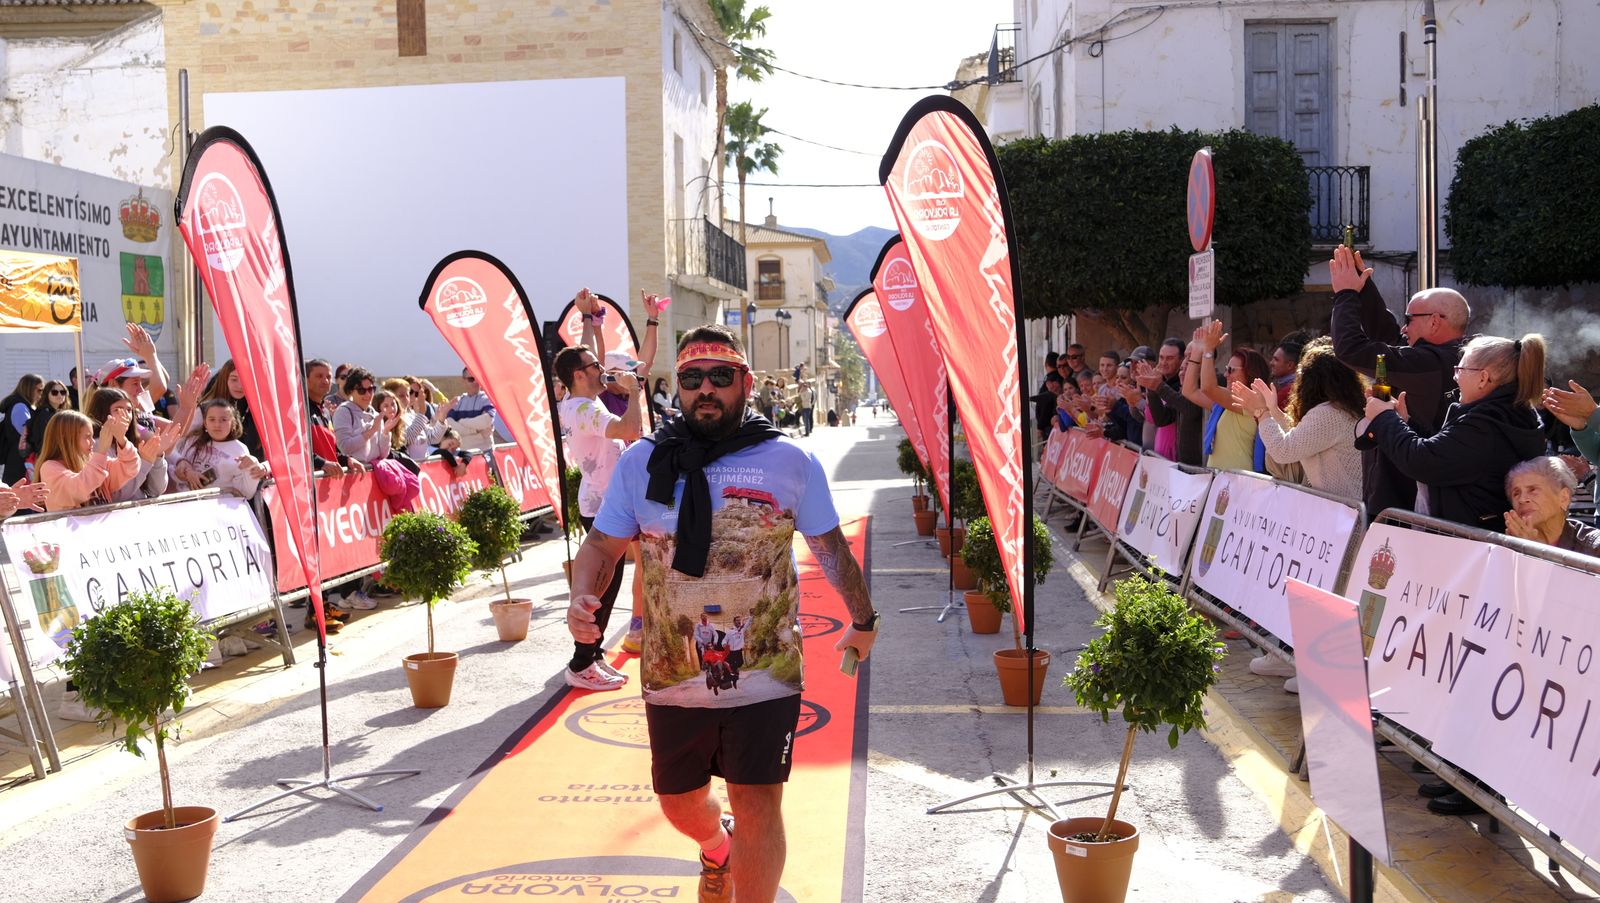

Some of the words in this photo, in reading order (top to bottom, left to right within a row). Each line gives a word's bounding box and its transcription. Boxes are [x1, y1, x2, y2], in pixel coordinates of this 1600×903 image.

[1, 223, 110, 258] AYUNTAMIENTO
[718, 473, 764, 485] JIMÉNEZ
[79, 529, 222, 569] AYUNTAMIENTO
[227, 524, 249, 541] DE
[1318, 540, 1334, 564] DE
[86, 545, 261, 613] CANTORIA
[1382, 615, 1600, 777] CANTORI
[780, 731, 791, 765] FILA
